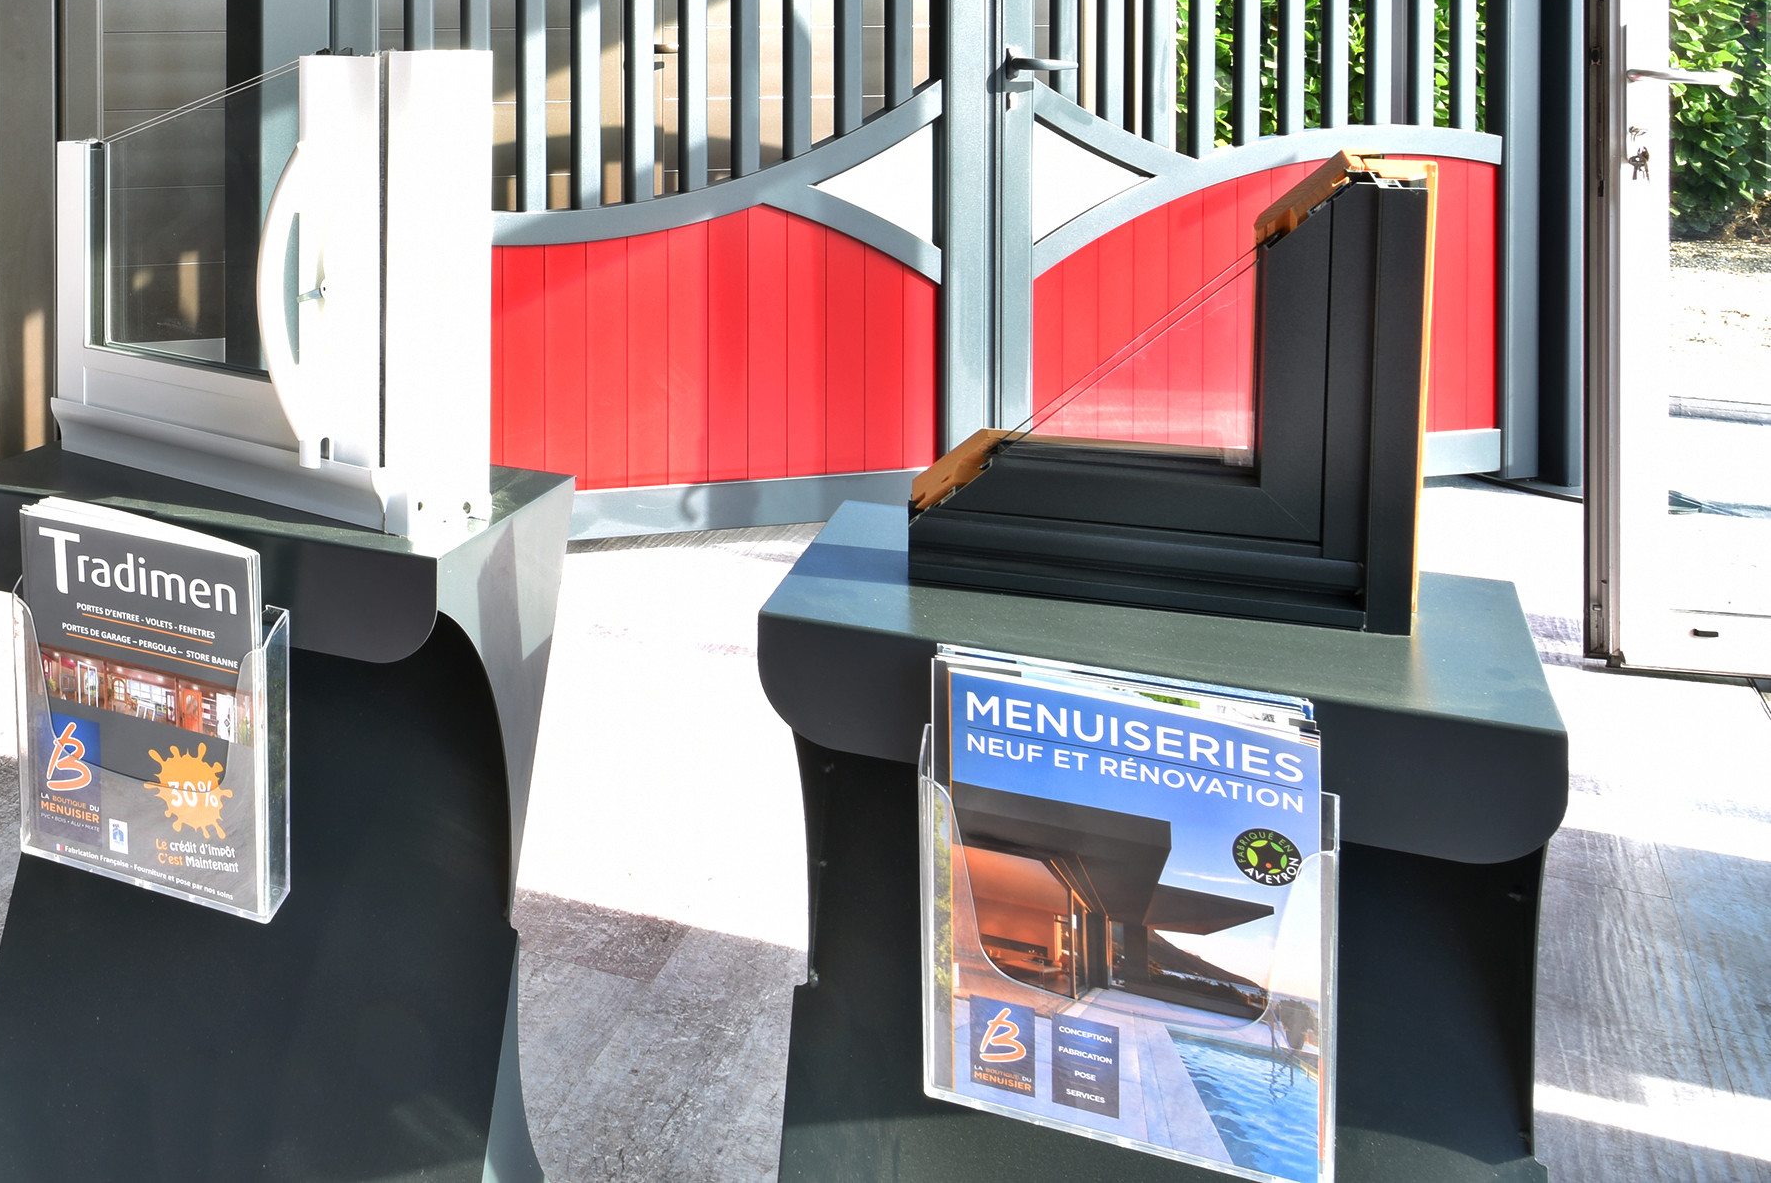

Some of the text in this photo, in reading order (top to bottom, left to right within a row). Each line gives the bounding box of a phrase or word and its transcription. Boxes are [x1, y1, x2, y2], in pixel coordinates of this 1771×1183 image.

[38, 526, 238, 616] Tradimen
[76, 602, 104, 615] PORTES
[104, 608, 140, 623] D'ENTREE
[145, 617, 173, 630] VOLETS
[178, 624, 216, 640] FENETRES
[61, 622, 89, 635] PORTES
[90, 628, 100, 638] DE
[101, 631, 132, 645] GARAGE
[138, 639, 177, 655] PERGOLAS
[186, 649, 210, 663] STORE
[211, 656, 239, 669] BANNE
[966, 691, 1304, 783] MENUISERIES
[967, 732, 1304, 814] NEUF ET RÉNOVATION
[40, 792, 100, 813] LA BOUTIQUE DU
[167, 780, 219, 808] 30%
[40, 800, 100, 824] MENUISIER
[155, 838, 236, 859] Le crédit d'impôt
[1236, 831, 1294, 864] FABRIQUÉ EN
[64, 845, 99, 861] Fabrication
[99, 854, 129, 868] Française
[133, 863, 167, 880] Fourniture
[167, 874, 175, 882] et
[175, 877, 191, 887] pose
[191, 882, 203, 891] par
[203, 885, 216, 895] nos
[216, 889, 234, 901] soins
[157, 852, 239, 873] C'est Maintenant
[1244, 857, 1300, 884] AVEYRON
[1058, 1025, 1113, 1044] CONCEPTION
[1058, 1045, 1113, 1065] FABRICATION
[973, 1070, 1032, 1092] MENUISIER
[974, 1064, 1032, 1083] LA BOUTIQUE DU
[1074, 1069, 1097, 1082] POSE
[1065, 1088, 1107, 1104] SERVICES
